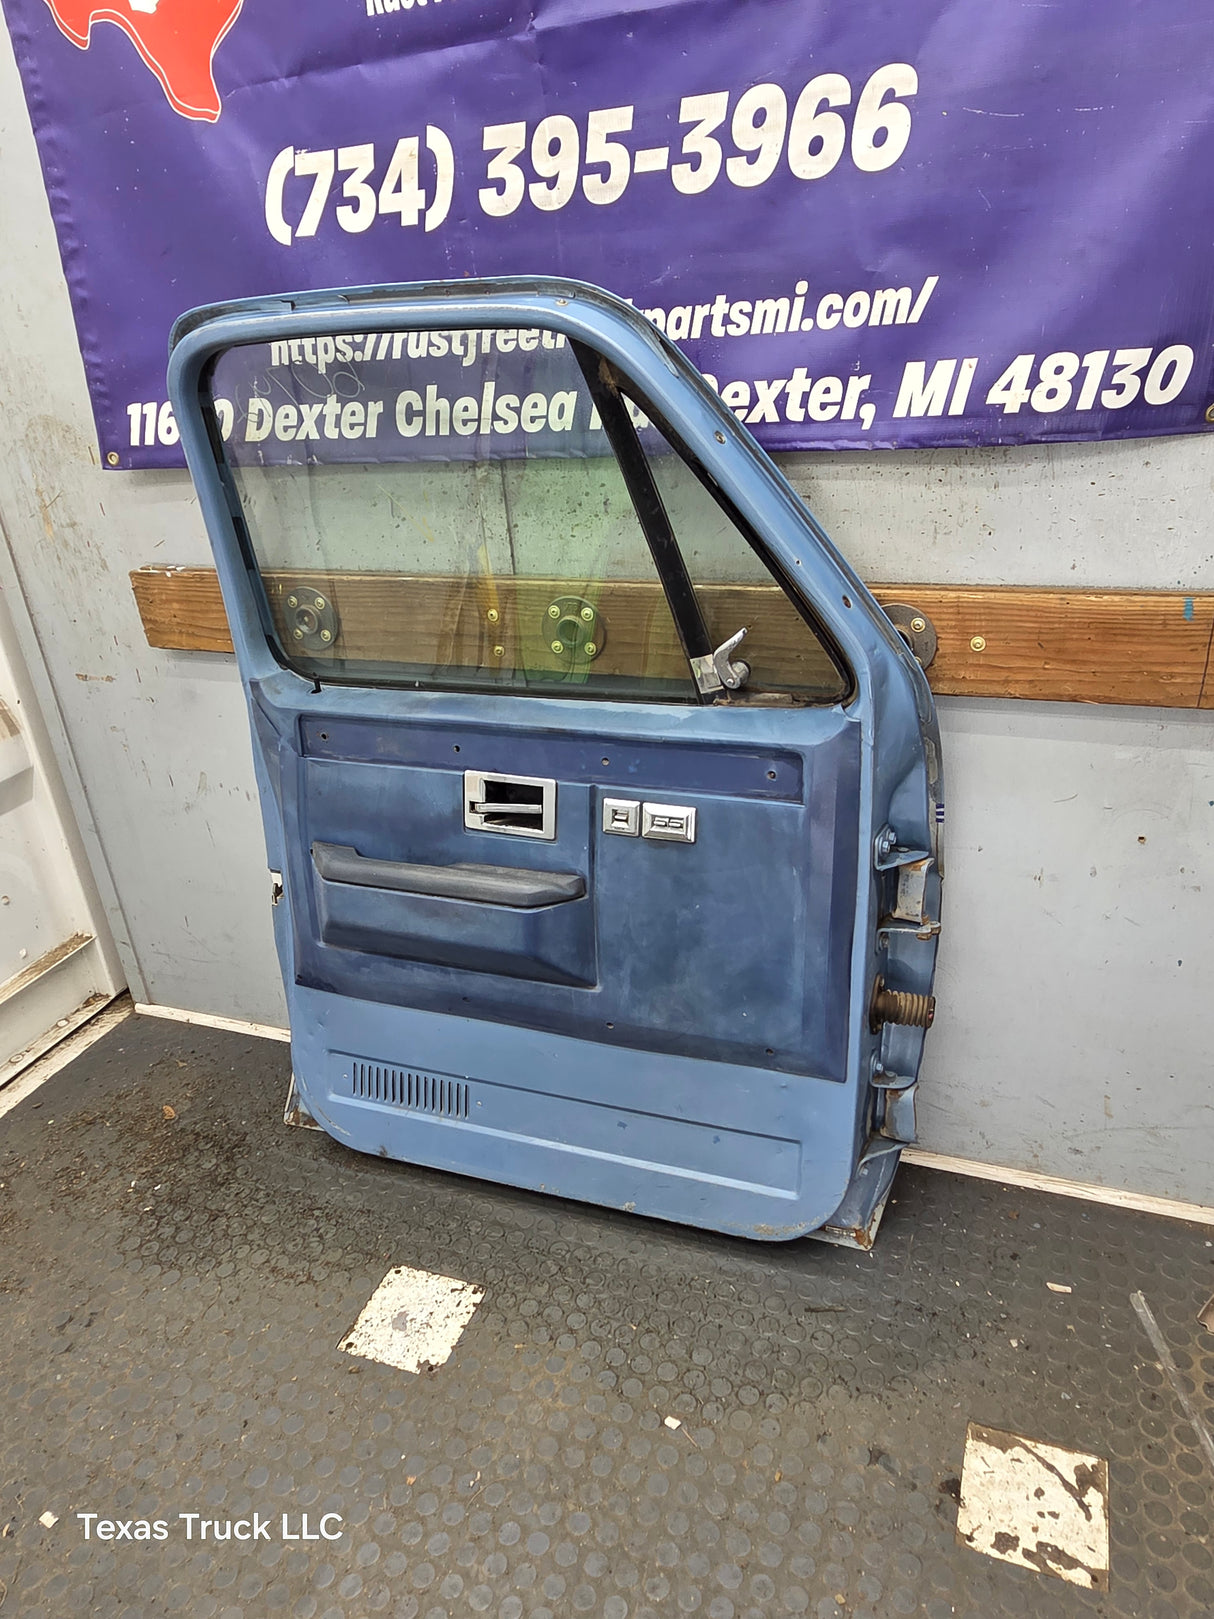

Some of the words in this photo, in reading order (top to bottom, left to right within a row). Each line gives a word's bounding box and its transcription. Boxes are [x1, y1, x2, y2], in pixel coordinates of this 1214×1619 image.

[264, 124, 455, 246] (734)
[478, 63, 918, 217] 395-3966
[126, 398, 234, 446] 1160
[244, 394, 384, 442] Dexter
[395, 381, 578, 438] Chelsea
[892, 357, 979, 418] MI
[985, 345, 1195, 415] 48130
